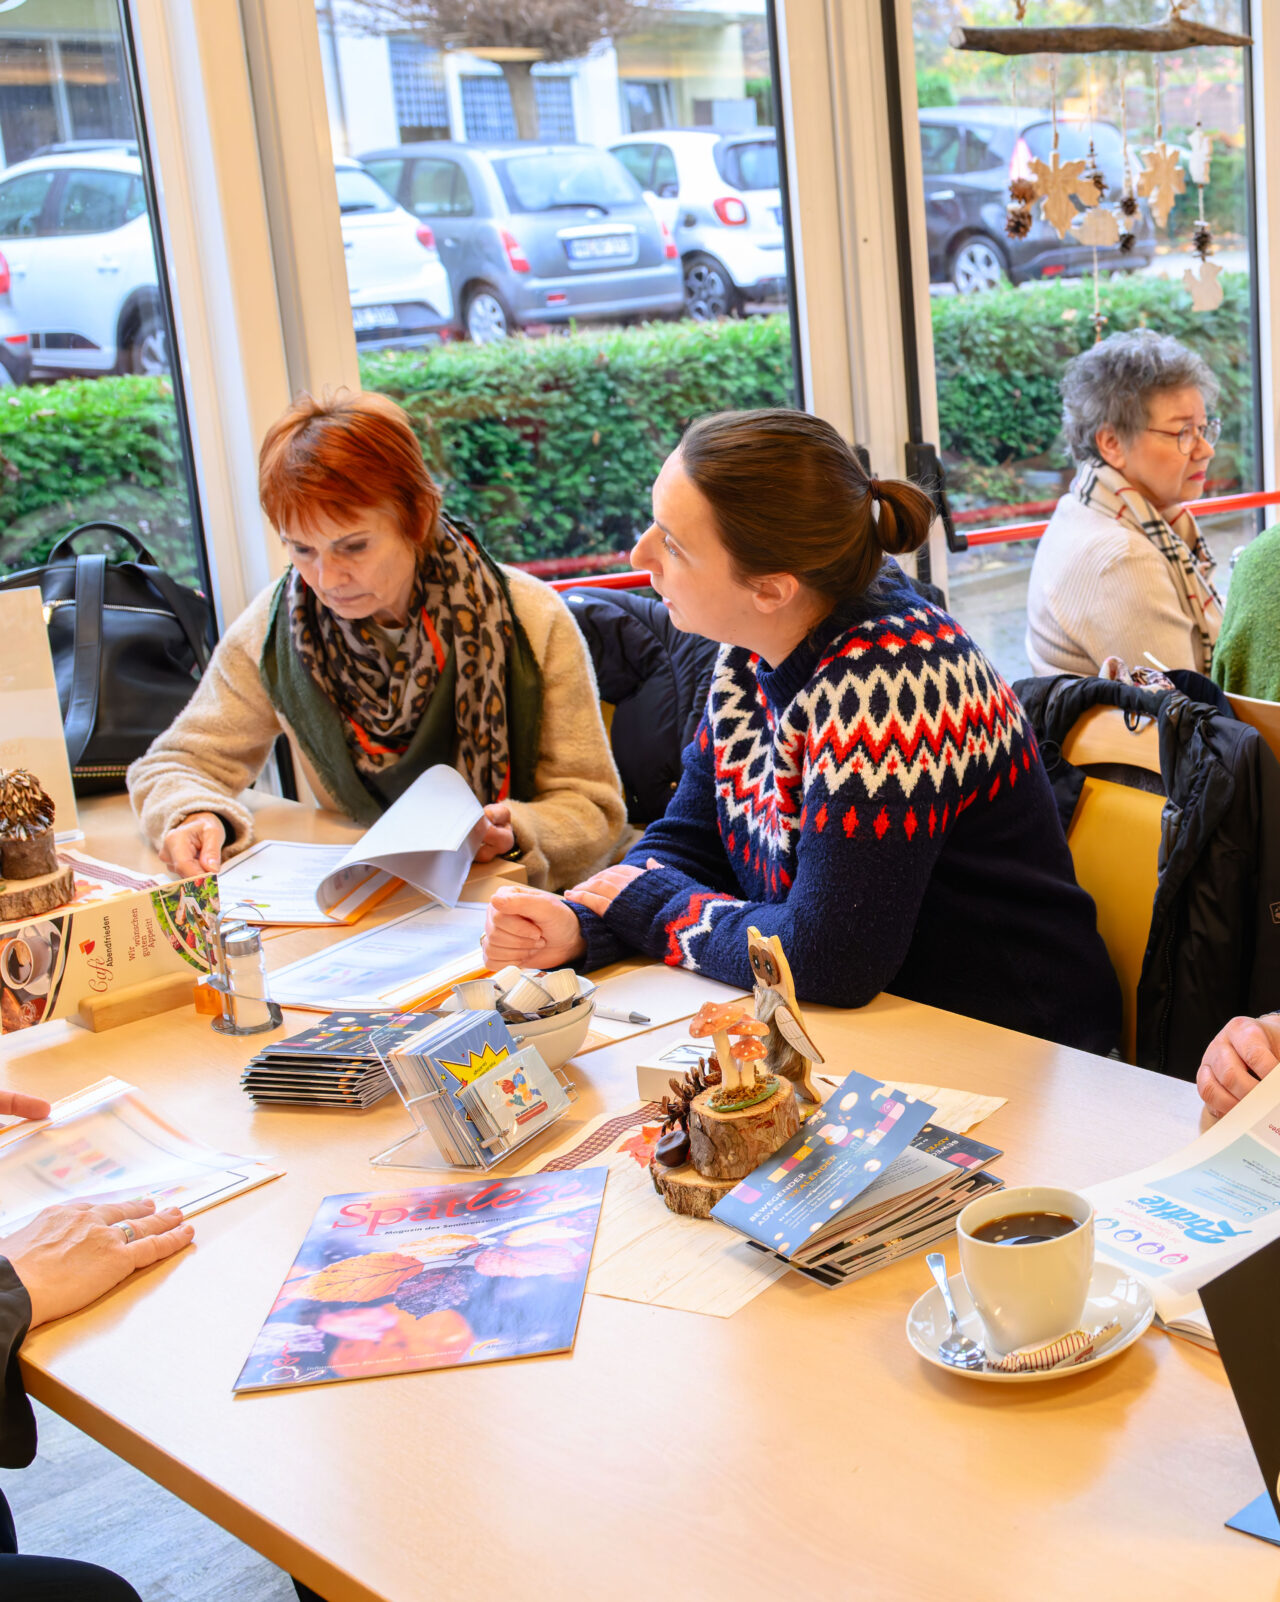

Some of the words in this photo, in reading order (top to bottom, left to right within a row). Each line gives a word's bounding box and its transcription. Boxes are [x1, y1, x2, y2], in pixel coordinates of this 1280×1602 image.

[131, 908, 141, 948] wünschen
[141, 935, 151, 957] guten
[146, 918, 156, 948] Appetit!
[87, 956, 114, 993] Café
[103, 915, 114, 967] Abendfrieden
[128, 946, 136, 961] Wir
[332, 1182, 591, 1237] Spätlese
[749, 1173, 807, 1222] BEWEGENDER
